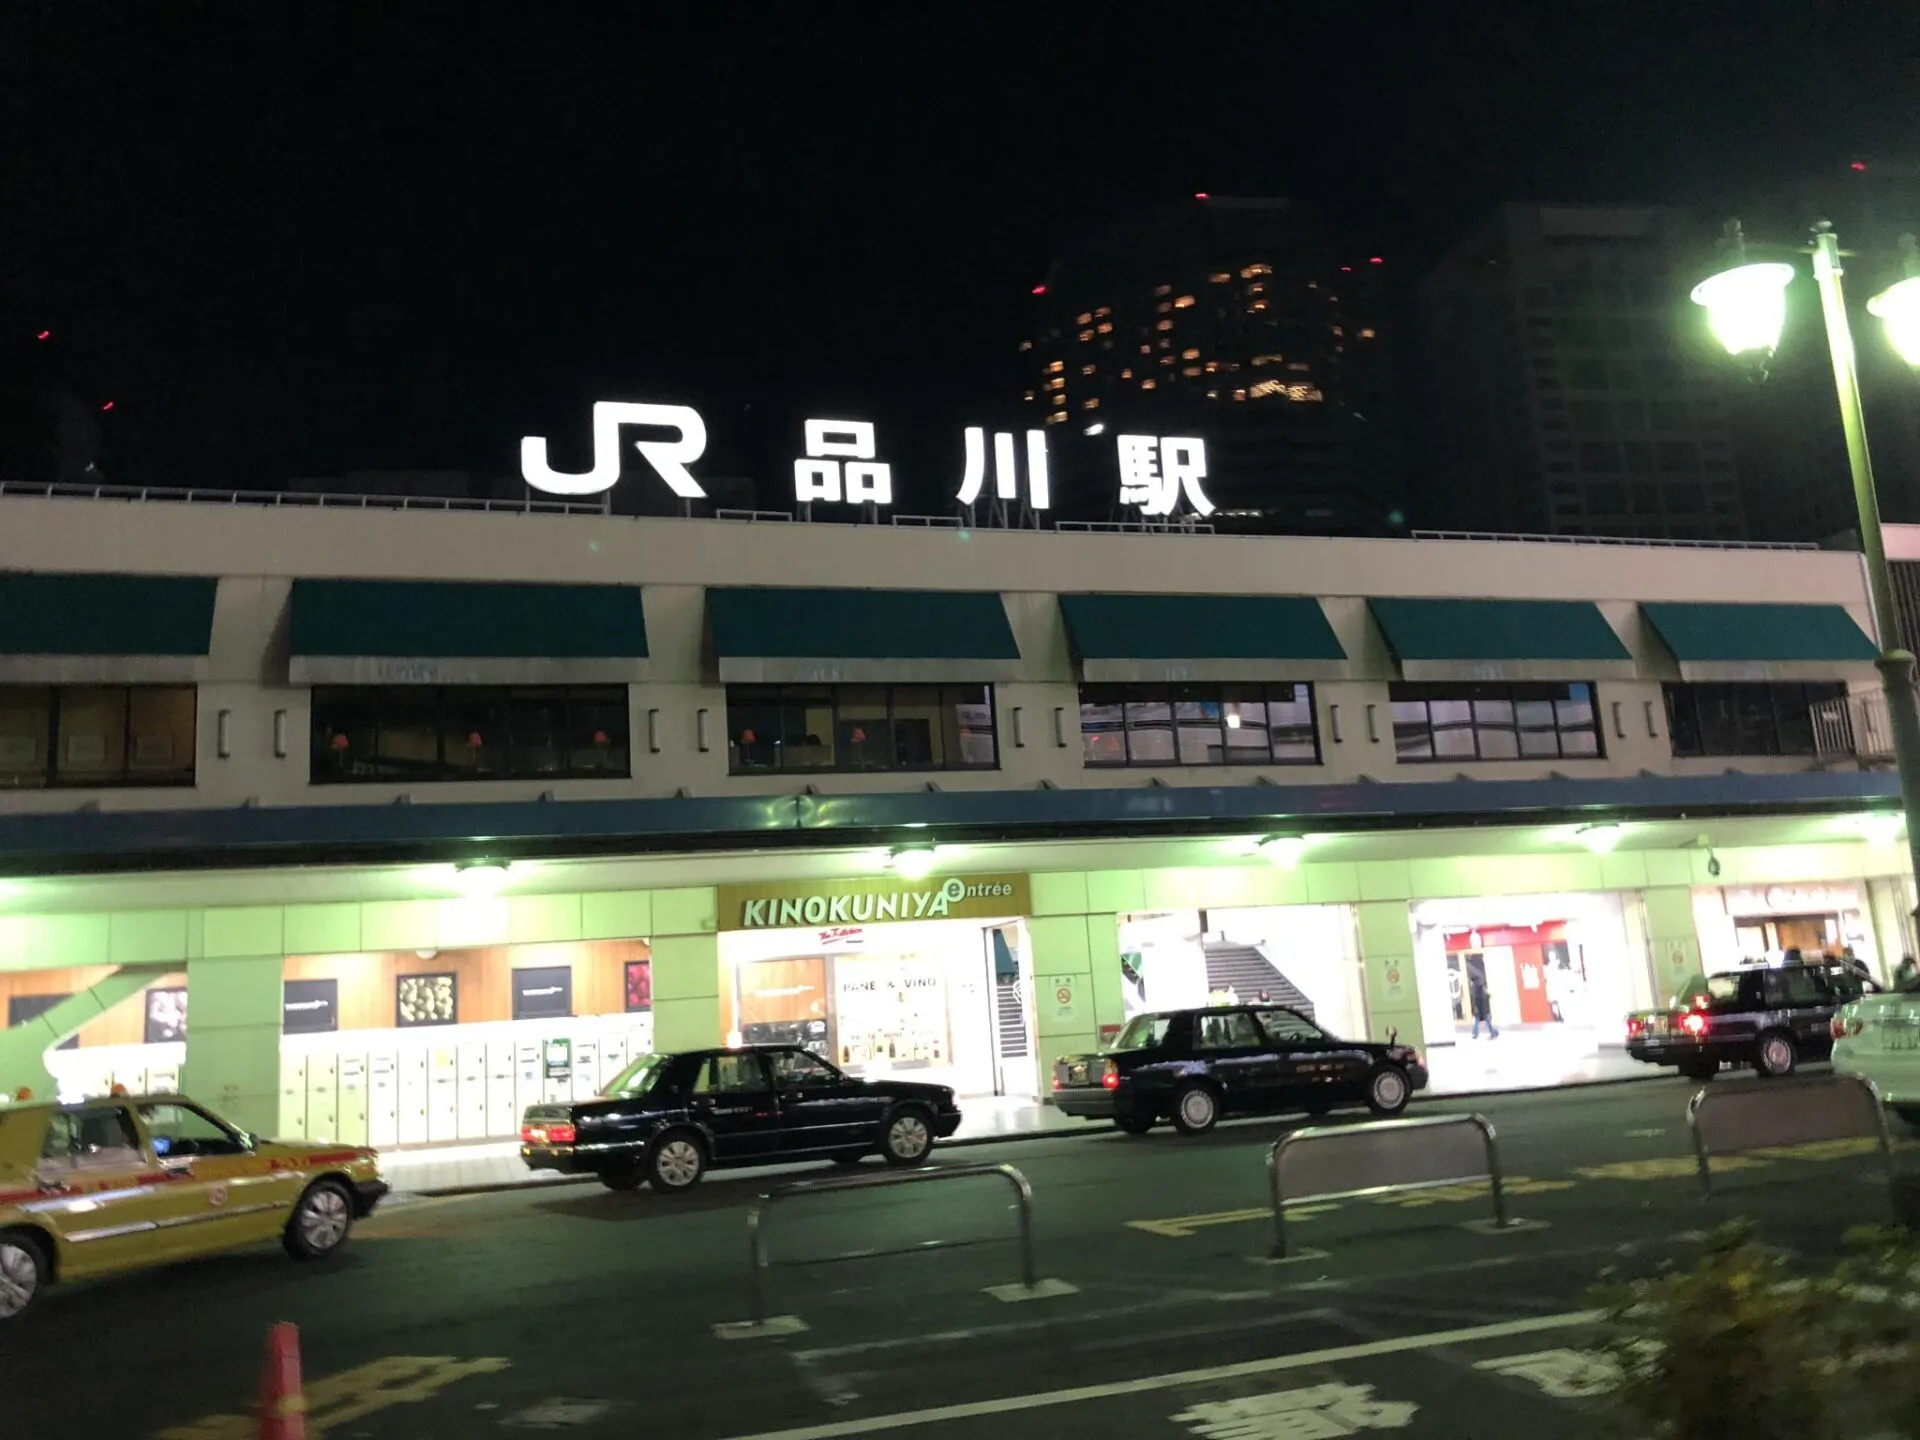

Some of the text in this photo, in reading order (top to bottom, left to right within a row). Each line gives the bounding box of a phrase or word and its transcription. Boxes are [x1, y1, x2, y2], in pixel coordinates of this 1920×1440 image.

[520, 401, 708, 498] JR
[794, 418, 1216, 516] 品川駅
[744, 892, 950, 927] KINOKUNIYA
